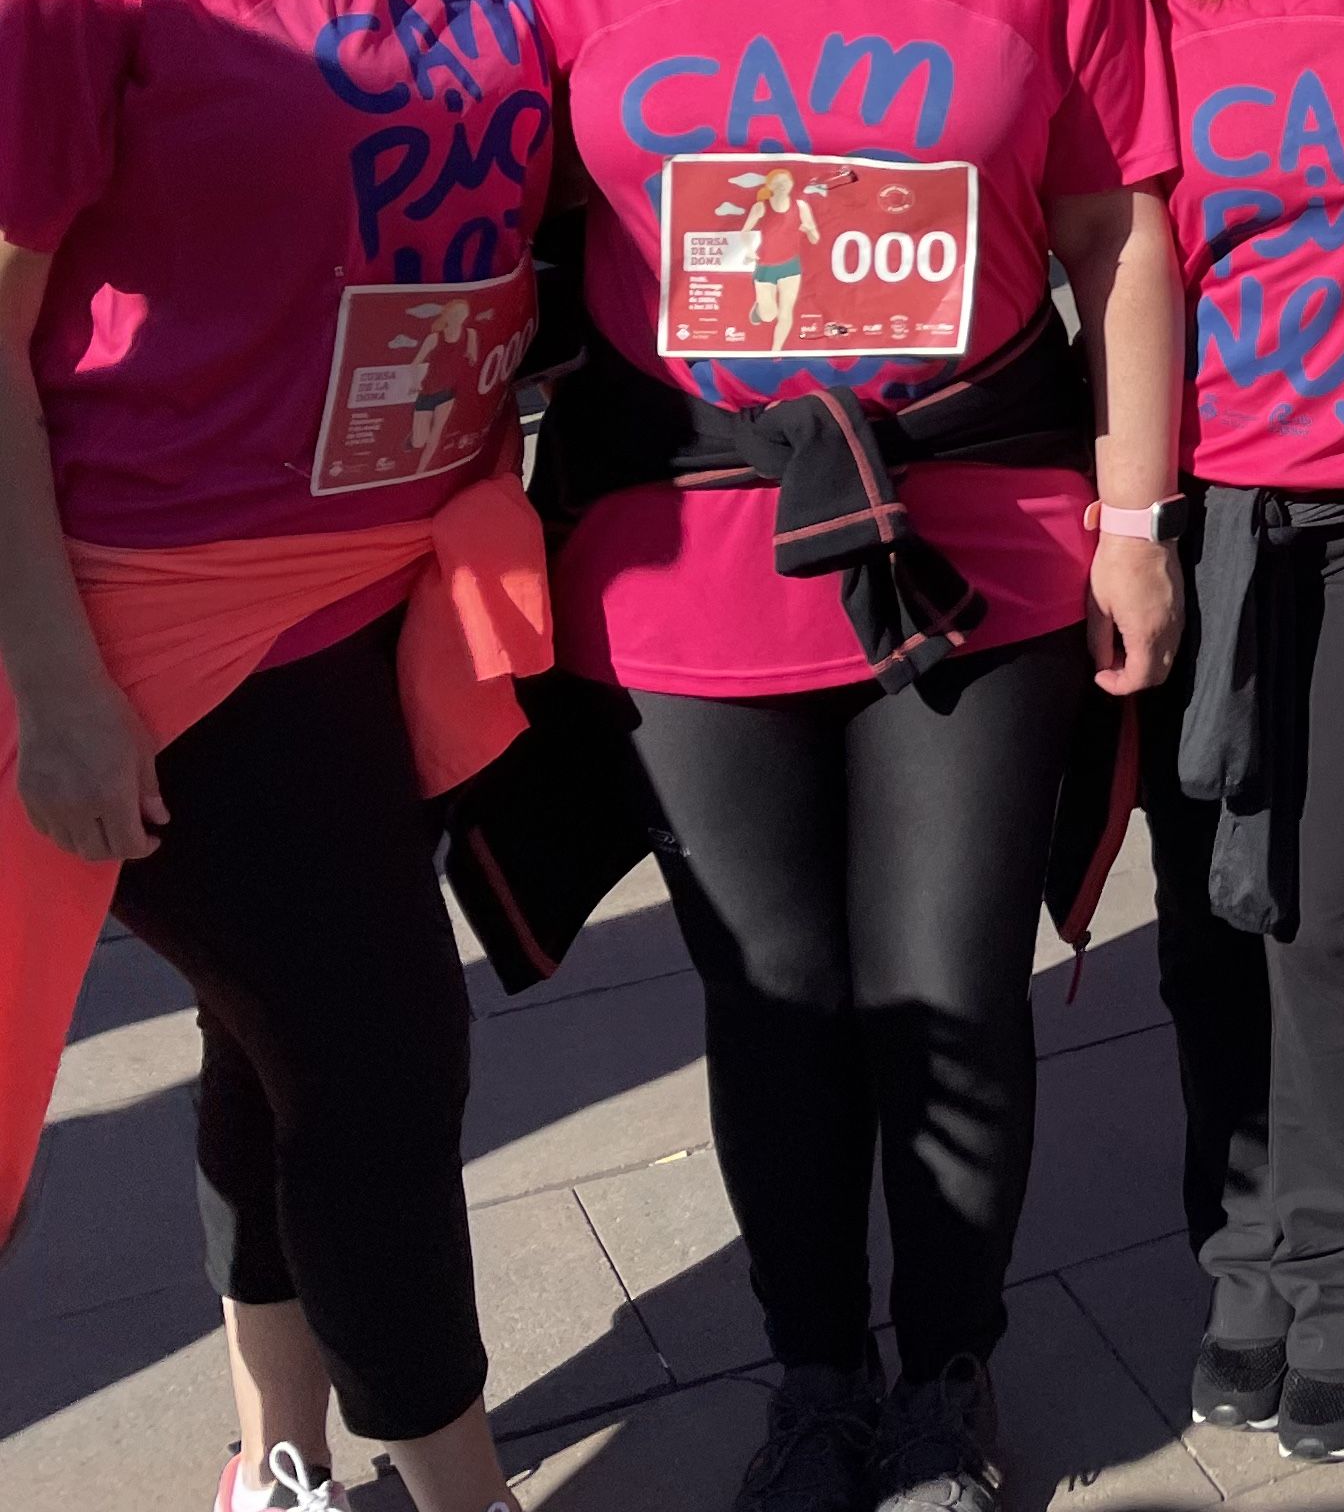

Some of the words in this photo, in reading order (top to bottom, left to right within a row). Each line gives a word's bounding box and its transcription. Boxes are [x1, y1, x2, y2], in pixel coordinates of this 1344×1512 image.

[621, 31, 956, 156] CAM
[691, 248, 706, 256] DE
[709, 248, 724, 256] LA
[830, 230, 958, 284] 000
